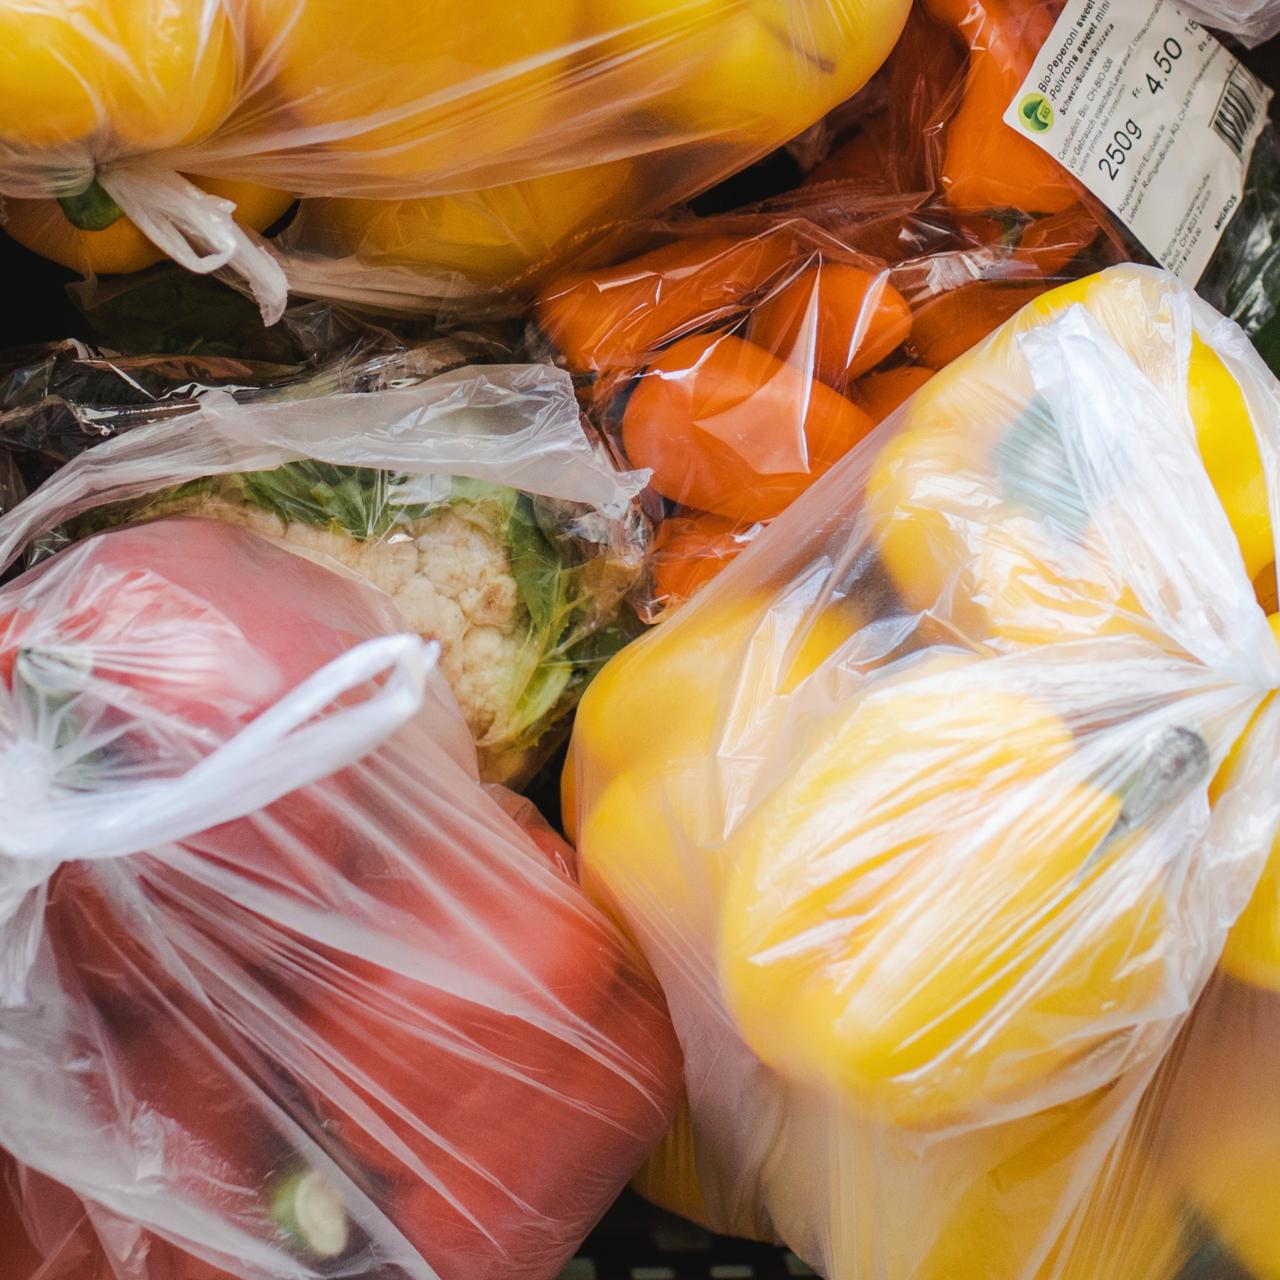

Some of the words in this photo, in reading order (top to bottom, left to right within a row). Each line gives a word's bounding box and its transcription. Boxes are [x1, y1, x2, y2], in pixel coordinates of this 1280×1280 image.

[1036, 26, 1081, 93] Bio-Peperoni
[1074, 22, 1098, 54] sweet
[1130, 84, 1143, 98] Fr.
[1138, 34, 1188, 97] 4.50
[1071, 118, 1098, 155] Gebrauch
[1093, 114, 1146, 181] 250g
[1212, 193, 1238, 231] MIGROS
